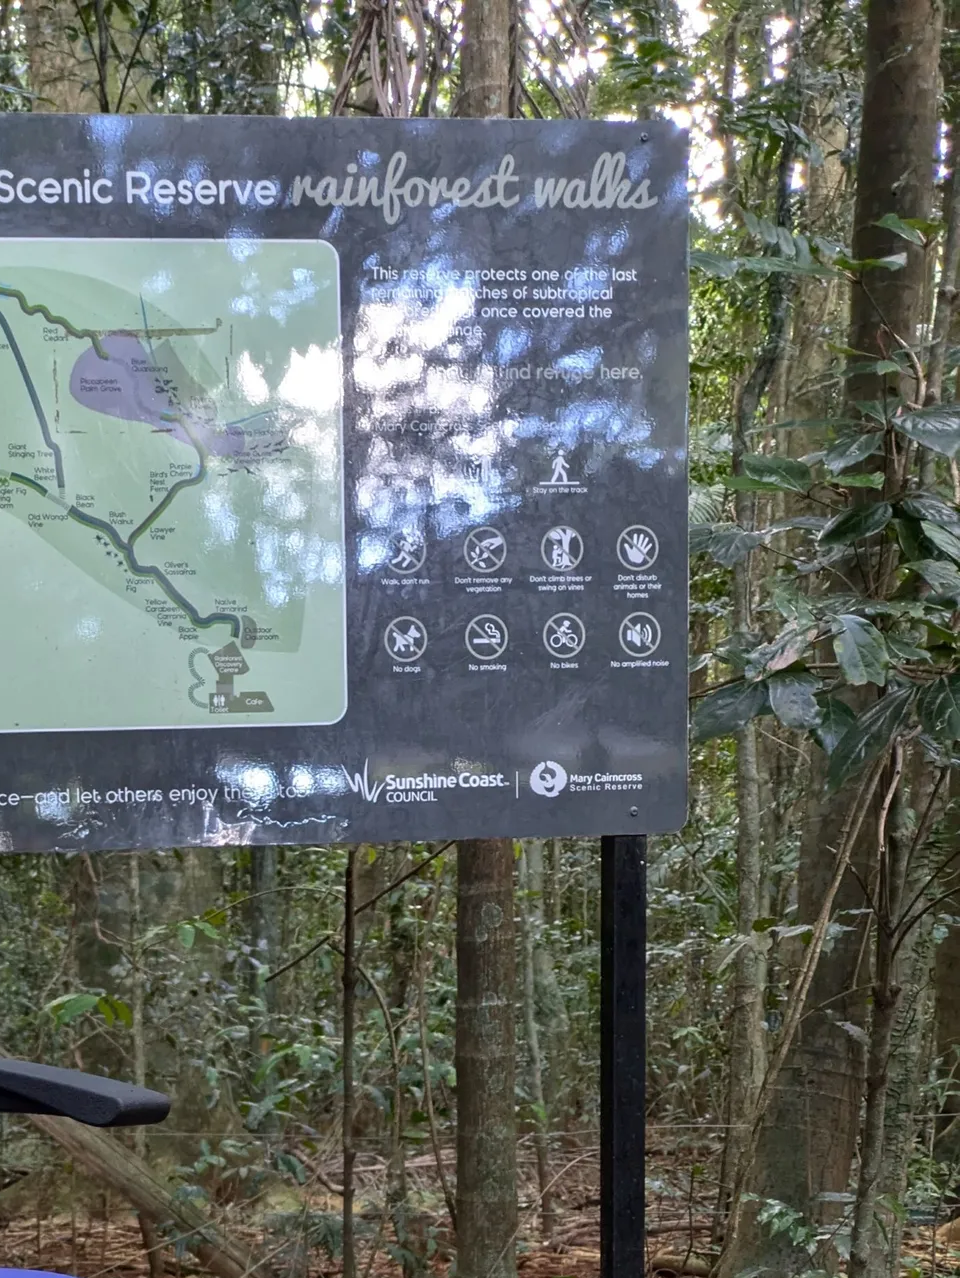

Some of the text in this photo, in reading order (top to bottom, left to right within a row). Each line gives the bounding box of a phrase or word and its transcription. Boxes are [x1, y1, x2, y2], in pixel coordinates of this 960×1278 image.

[125, 170, 277, 206] Reserve
[292, 151, 521, 226] rainforest
[534, 151, 659, 210] walks
[371, 266, 638, 284] This protects one of the last
[512, 285, 614, 302] of subtropical
[481, 306, 518, 319] once
[522, 304, 585, 319] covered
[589, 305, 613, 319] the
[600, 363, 644, 380] here.
[8, 450, 53, 459] Stinging Tree
[149, 478, 165, 486] Nest
[16, 487, 27, 496] Fig
[532, 485, 589, 495] Stay on the track
[75, 493, 95, 501] Black
[28, 513, 69, 522] Old Wonga
[149, 526, 176, 535] Lawyer
[500, 577, 513, 585] any
[547, 575, 566, 583] climb
[635, 574, 658, 582] disturb
[125, 585, 137, 593] Fig
[466, 585, 502, 593] vegetation
[538, 584, 557, 592] swing
[613, 583, 638, 591] animals
[157, 619, 173, 627] Vine
[178, 625, 198, 633] Black
[468, 663, 507, 671] No smoking
[561, 661, 579, 669] bikes
[610, 659, 670, 668] No amplified noise
[392, 665, 421, 673] No dogs
[386, 771, 505, 790] Sunshine Coast
[570, 772, 643, 785] Mary Cairncross
[570, 782, 643, 792] Scenic Reserve
[76, 788, 100, 804] let
[106, 786, 163, 804] others
[168, 786, 218, 805] enjoy
[386, 790, 438, 803] COUNCIL
